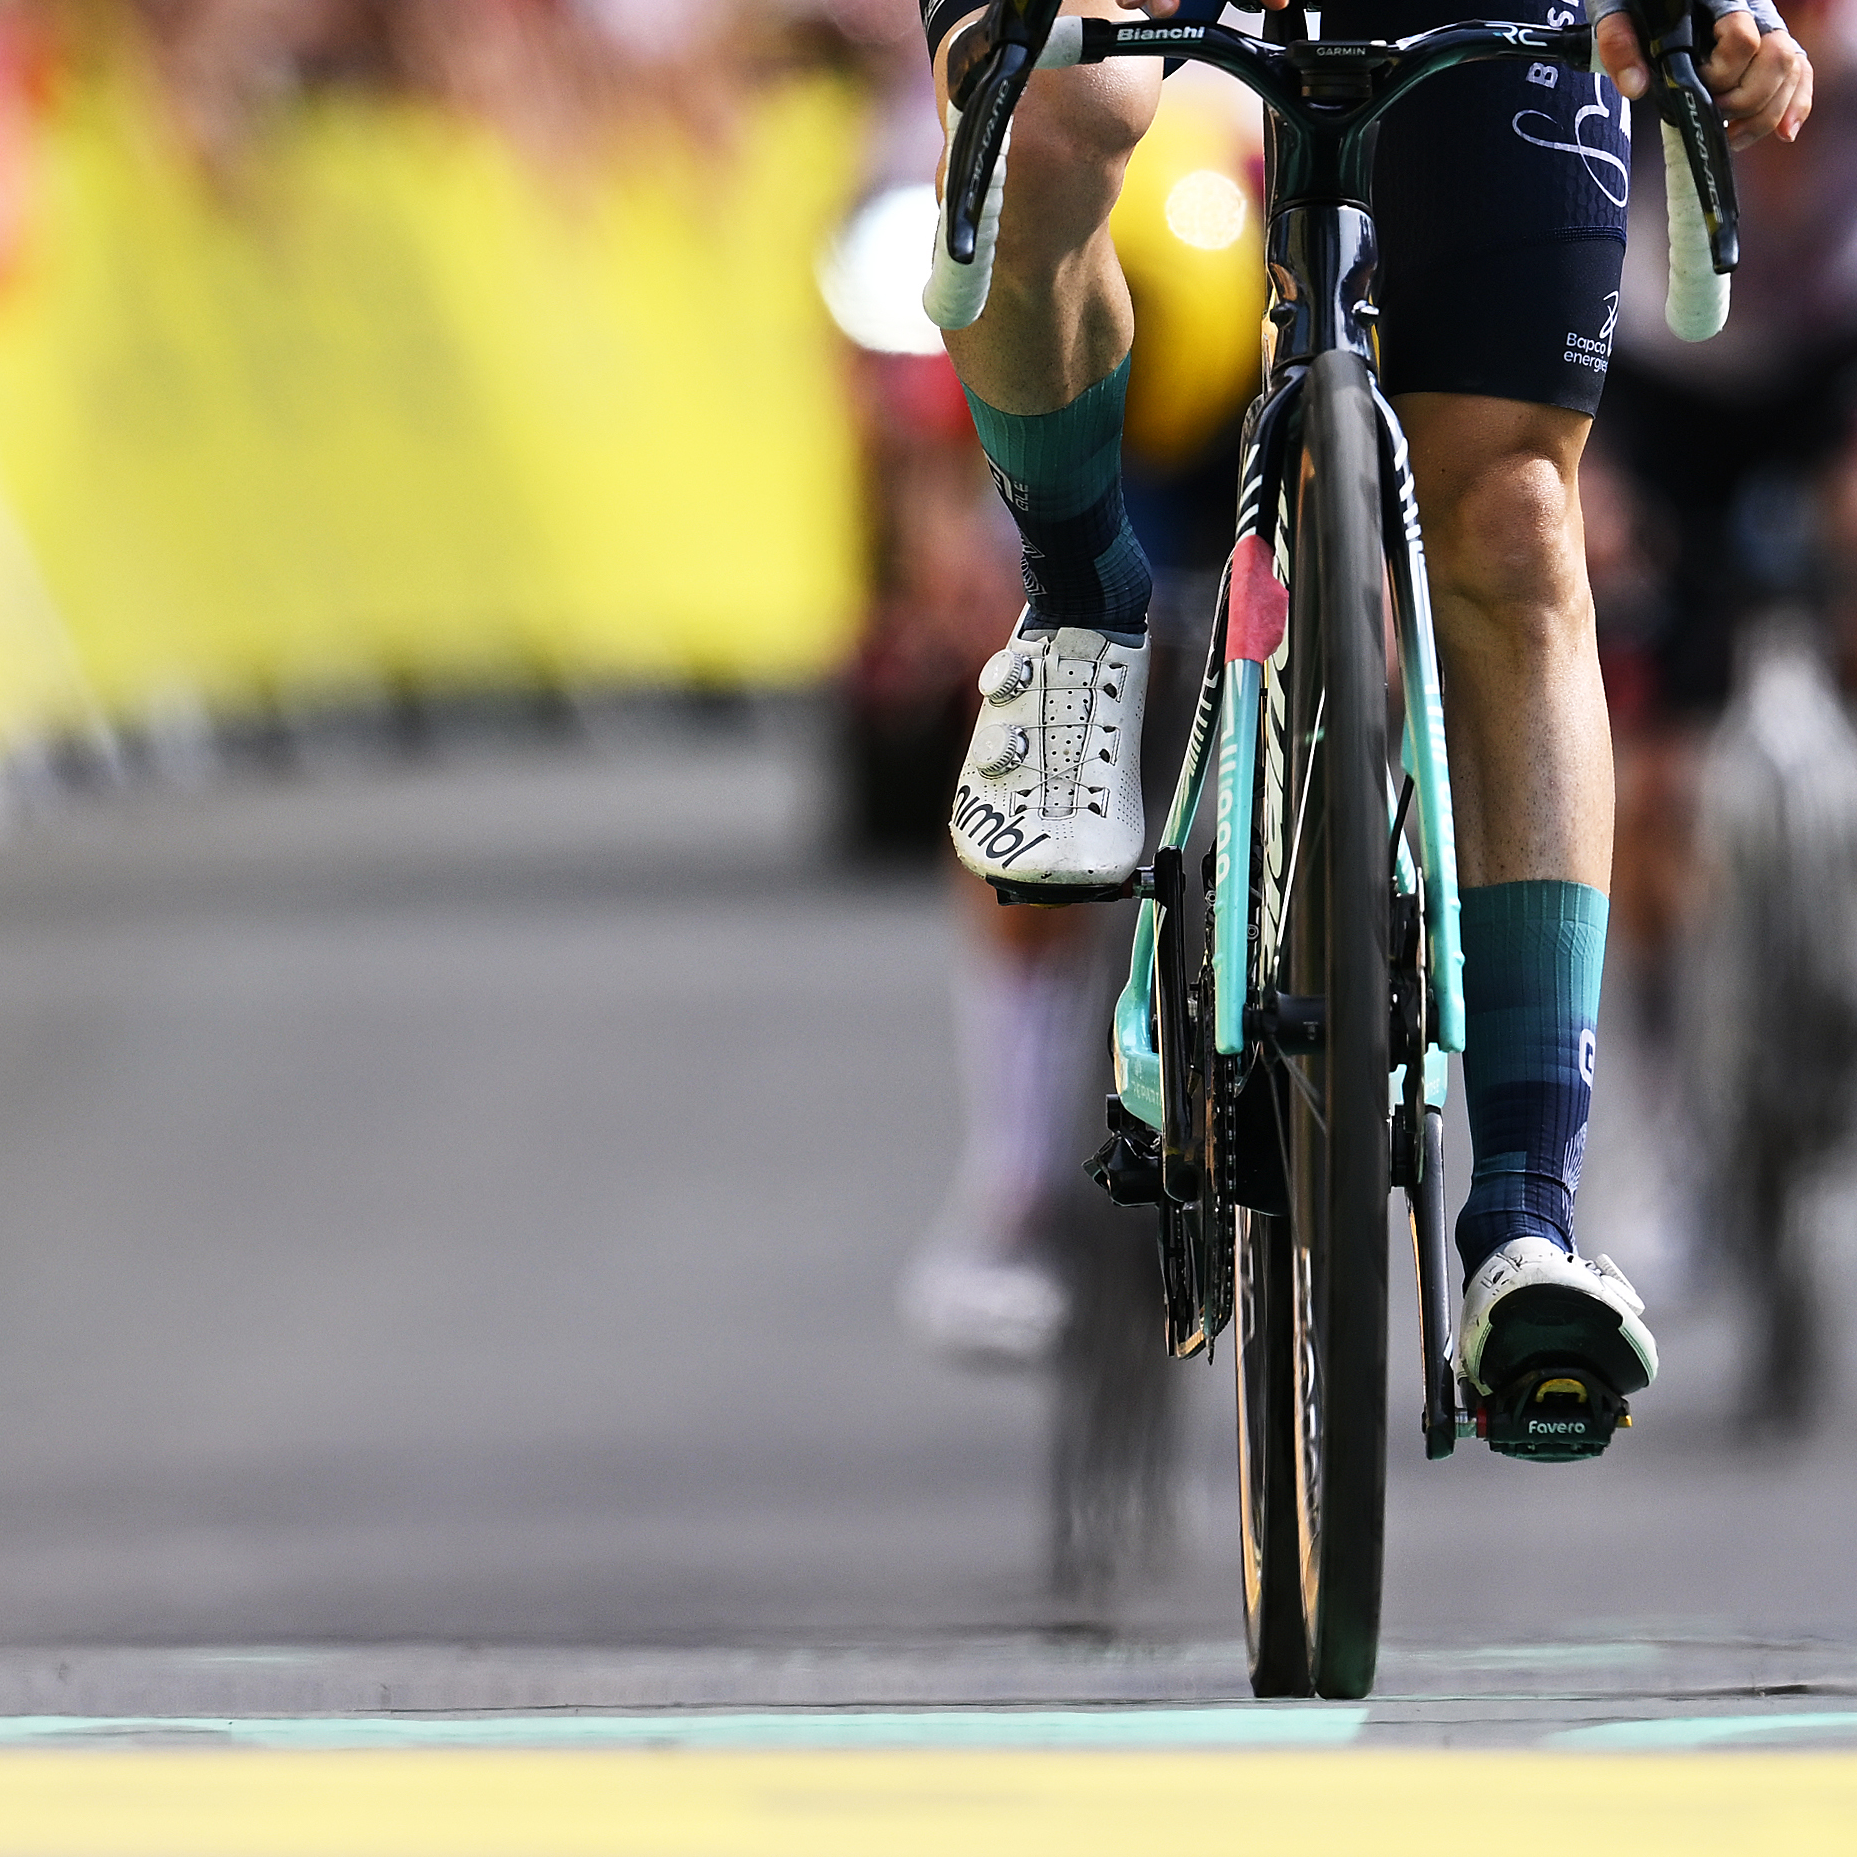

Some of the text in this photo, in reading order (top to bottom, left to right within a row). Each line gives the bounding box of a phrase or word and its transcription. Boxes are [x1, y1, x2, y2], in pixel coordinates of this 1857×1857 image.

[1116, 26, 1206, 42] Bianchi
[1316, 46, 1366, 57] GARMIN
[1684, 91, 1724, 224] DURA-ACE
[1566, 332, 1607, 355] Bapco
[953, 784, 1051, 870] nimbl
[1528, 1419, 1586, 1434] Favero
